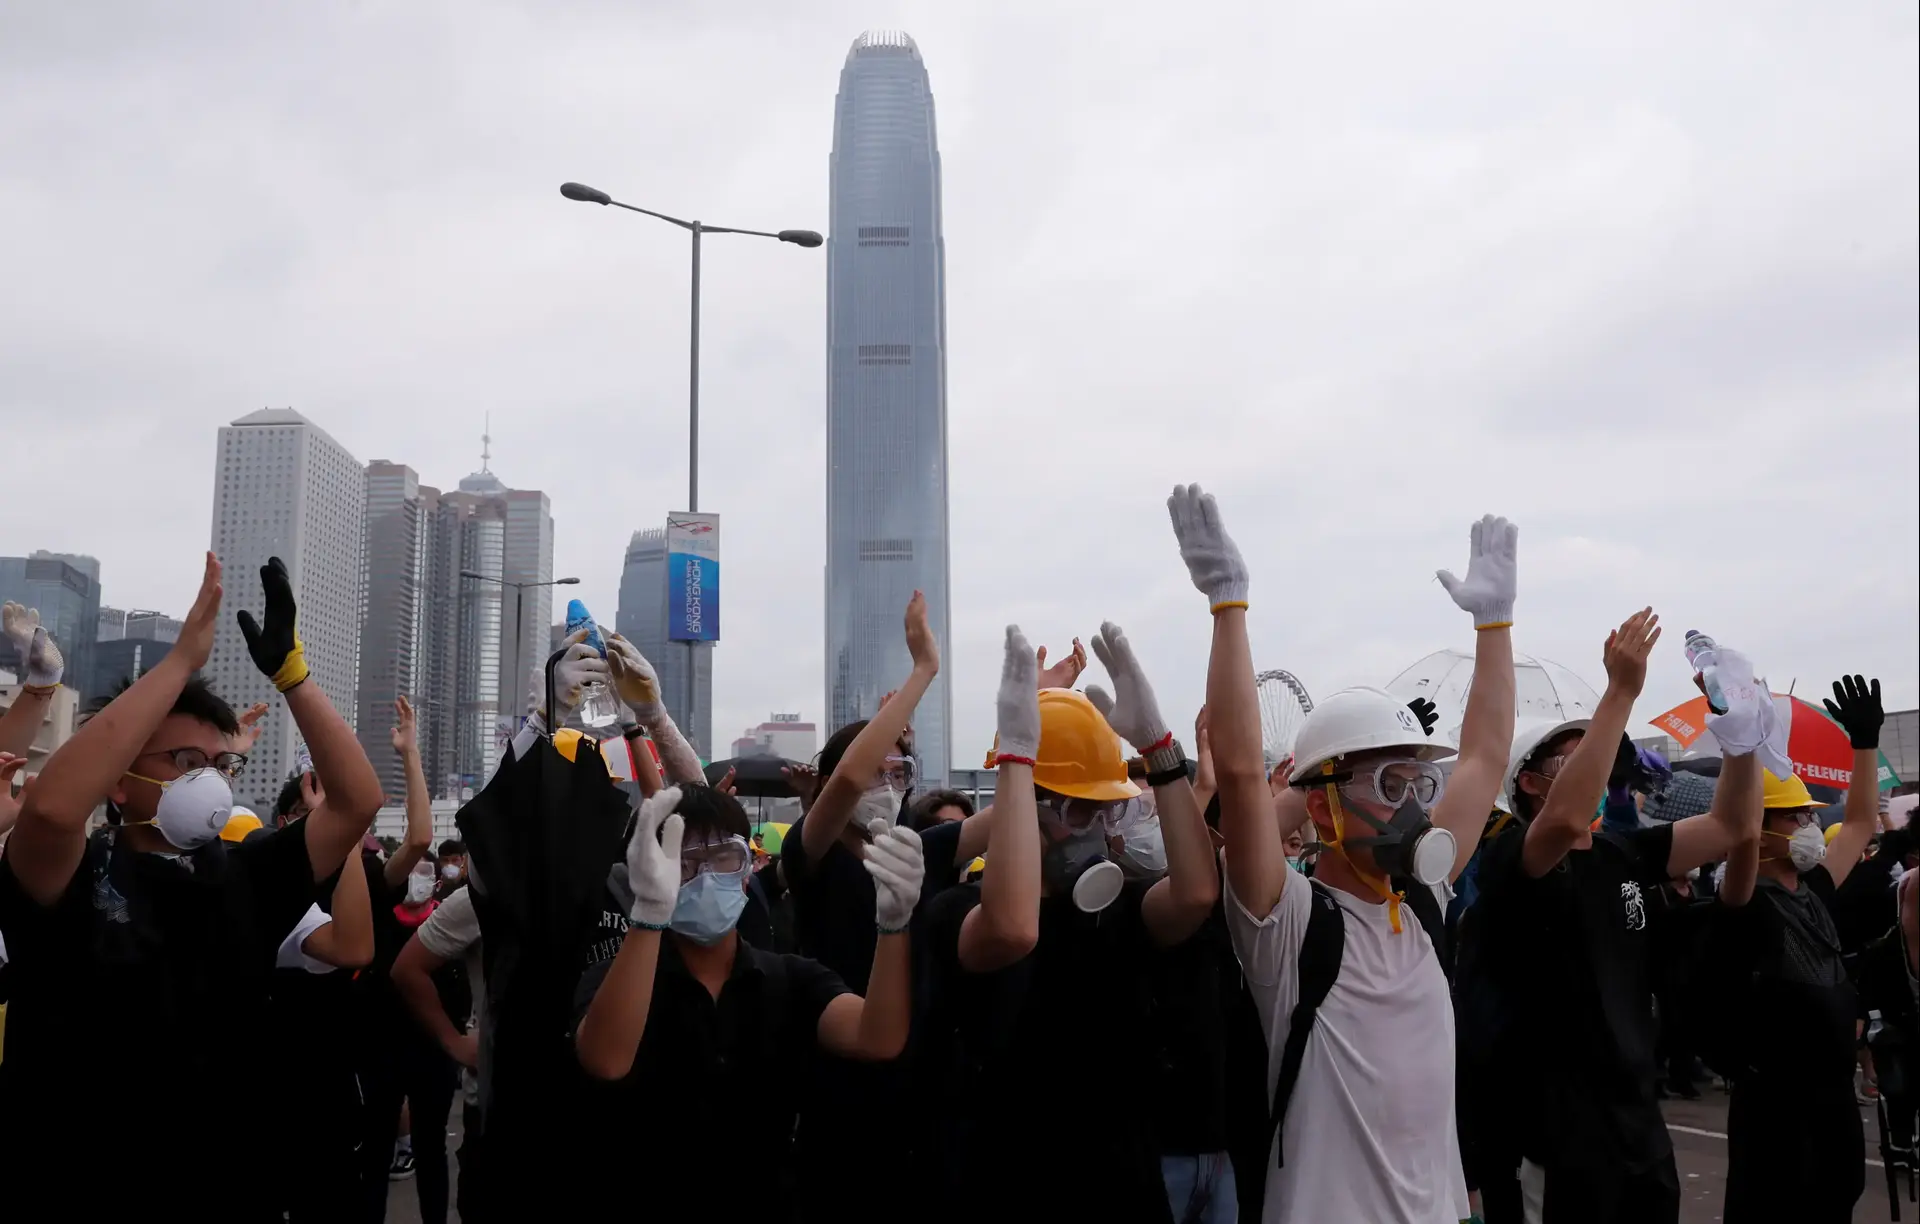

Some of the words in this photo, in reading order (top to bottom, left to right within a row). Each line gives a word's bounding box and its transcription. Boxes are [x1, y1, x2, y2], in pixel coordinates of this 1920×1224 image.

[692, 559, 701, 595] HONG
[692, 597, 701, 633] KONG
[598, 910, 629, 933] RTS
